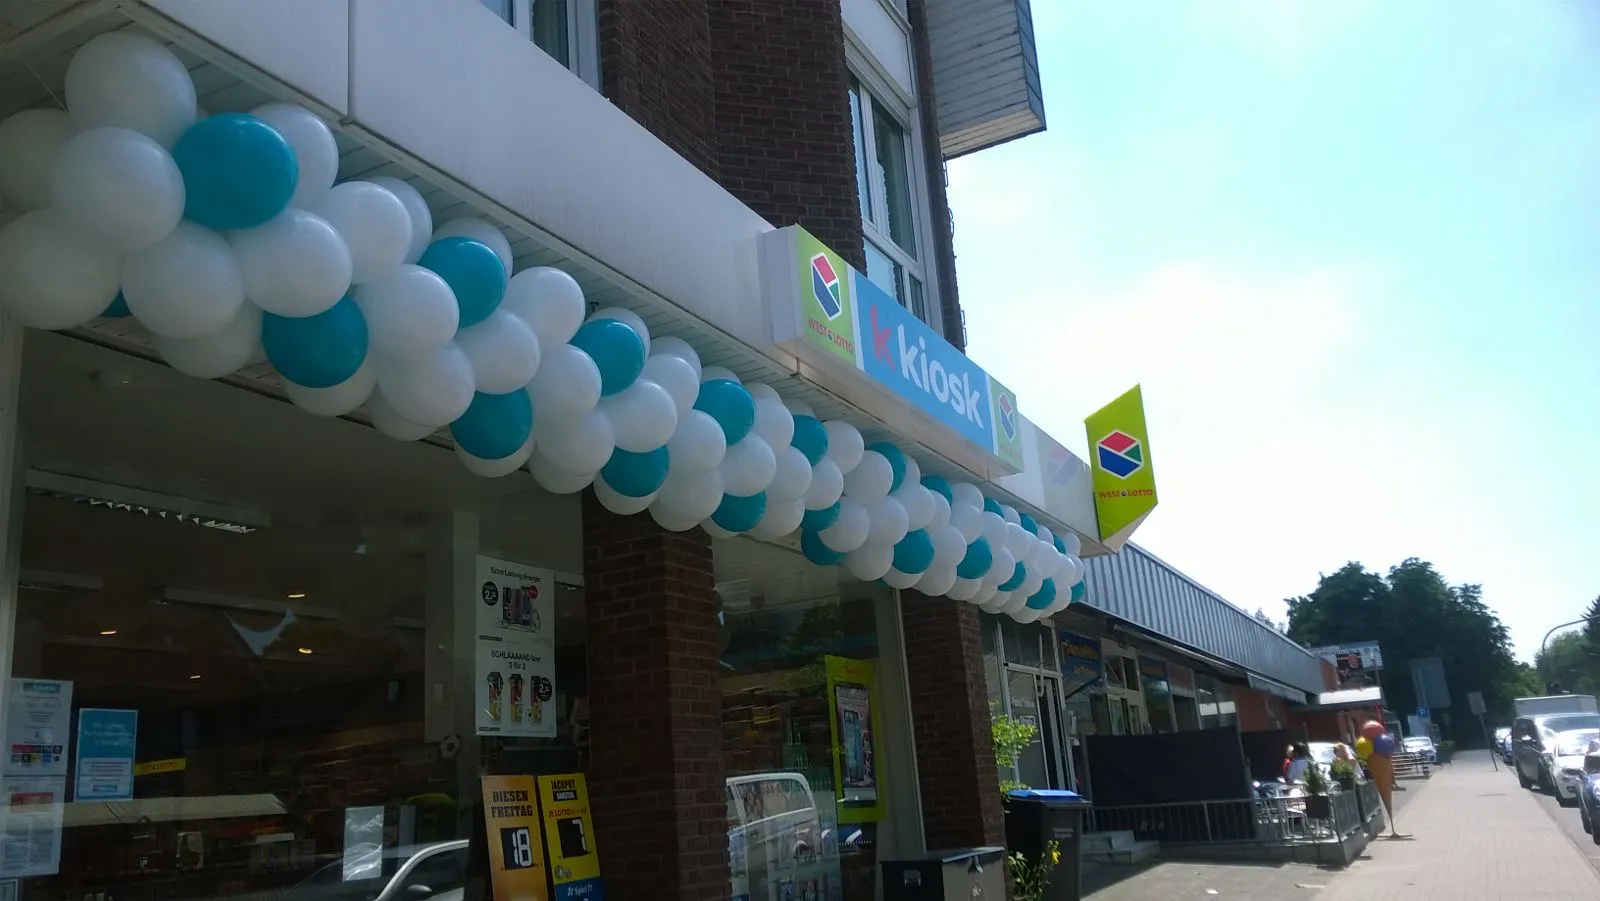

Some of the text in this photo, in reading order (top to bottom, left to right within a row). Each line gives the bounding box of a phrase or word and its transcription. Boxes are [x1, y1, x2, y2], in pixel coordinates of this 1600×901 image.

[807, 314, 854, 355] WEST LOTTO
[869, 305, 985, 429] k kiosk
[1098, 488, 1153, 499] WEST LOTTO
[551, 779, 575, 790] JACKPOT
[492, 790, 529, 803] DIESEN
[491, 805, 533, 817] FREITAG
[572, 819, 588, 852] 7
[511, 828, 533, 868] 18
